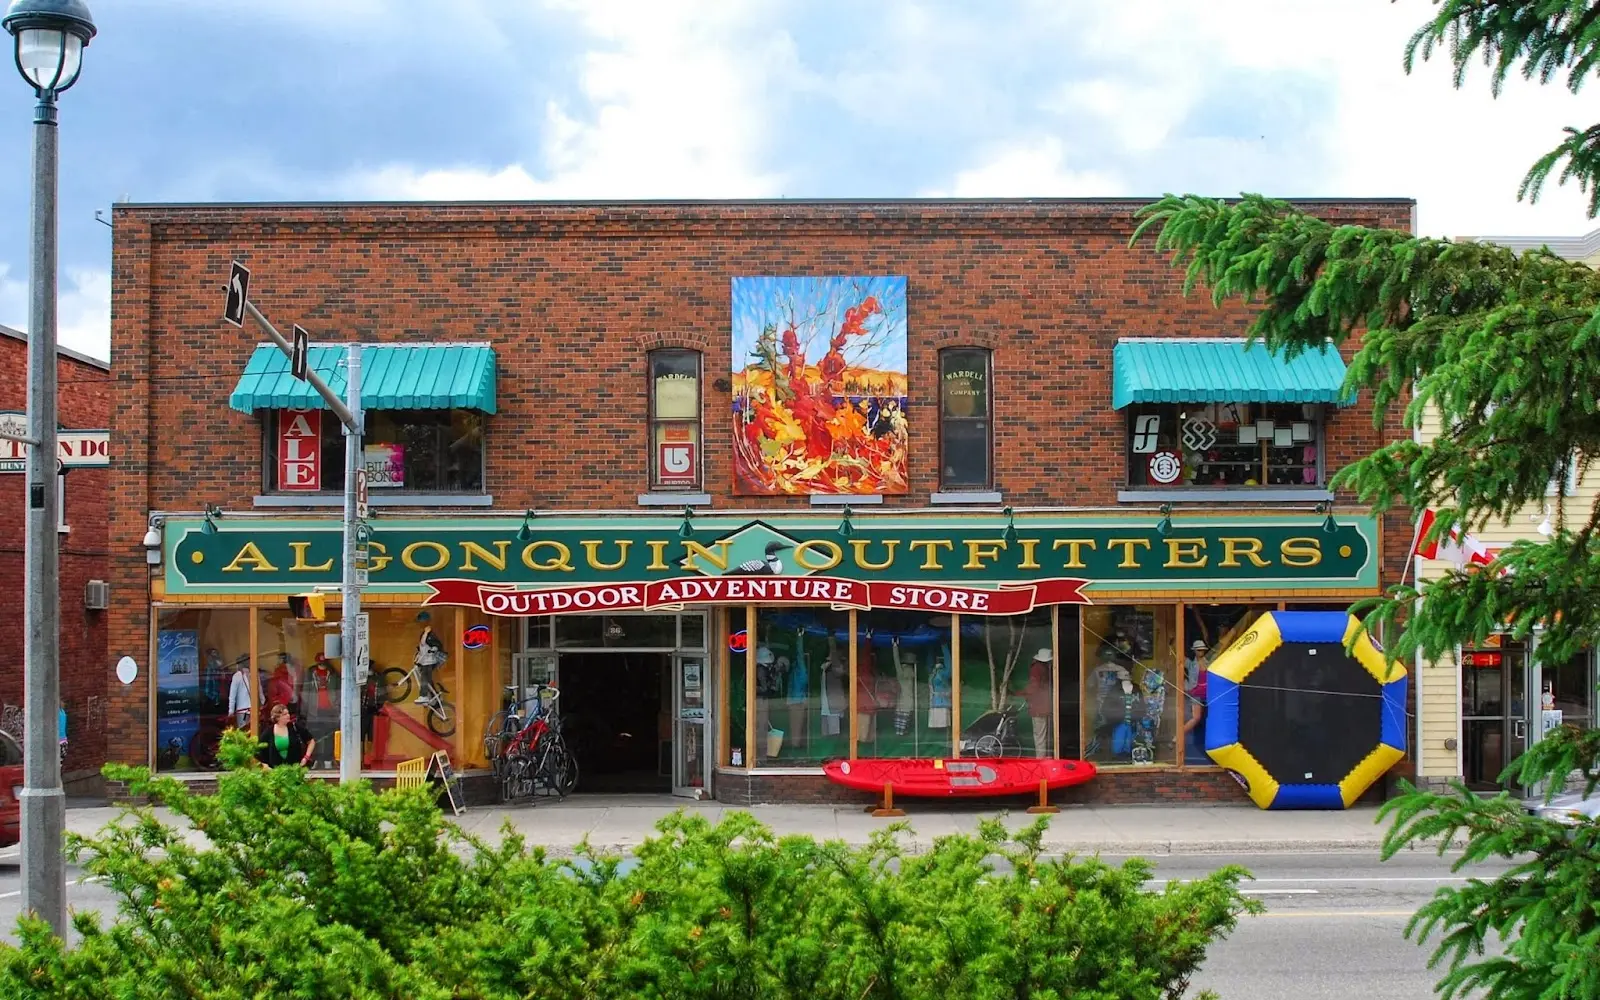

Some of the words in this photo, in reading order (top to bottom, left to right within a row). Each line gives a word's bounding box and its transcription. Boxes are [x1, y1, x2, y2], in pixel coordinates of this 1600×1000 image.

[946, 370, 983, 381] WARDELL
[283, 407, 317, 486] ALE
[366, 461, 404, 471] BILLA
[221, 540, 734, 572] ALGONQUIN
[793, 537, 1322, 571] OUTFITTERS
[486, 586, 641, 613] OUTDOOR
[657, 579, 853, 601] ADVENTURE
[889, 586, 990, 611] STORE
[161, 634, 174, 649] Sir
[463, 629, 491, 645] OPEN
